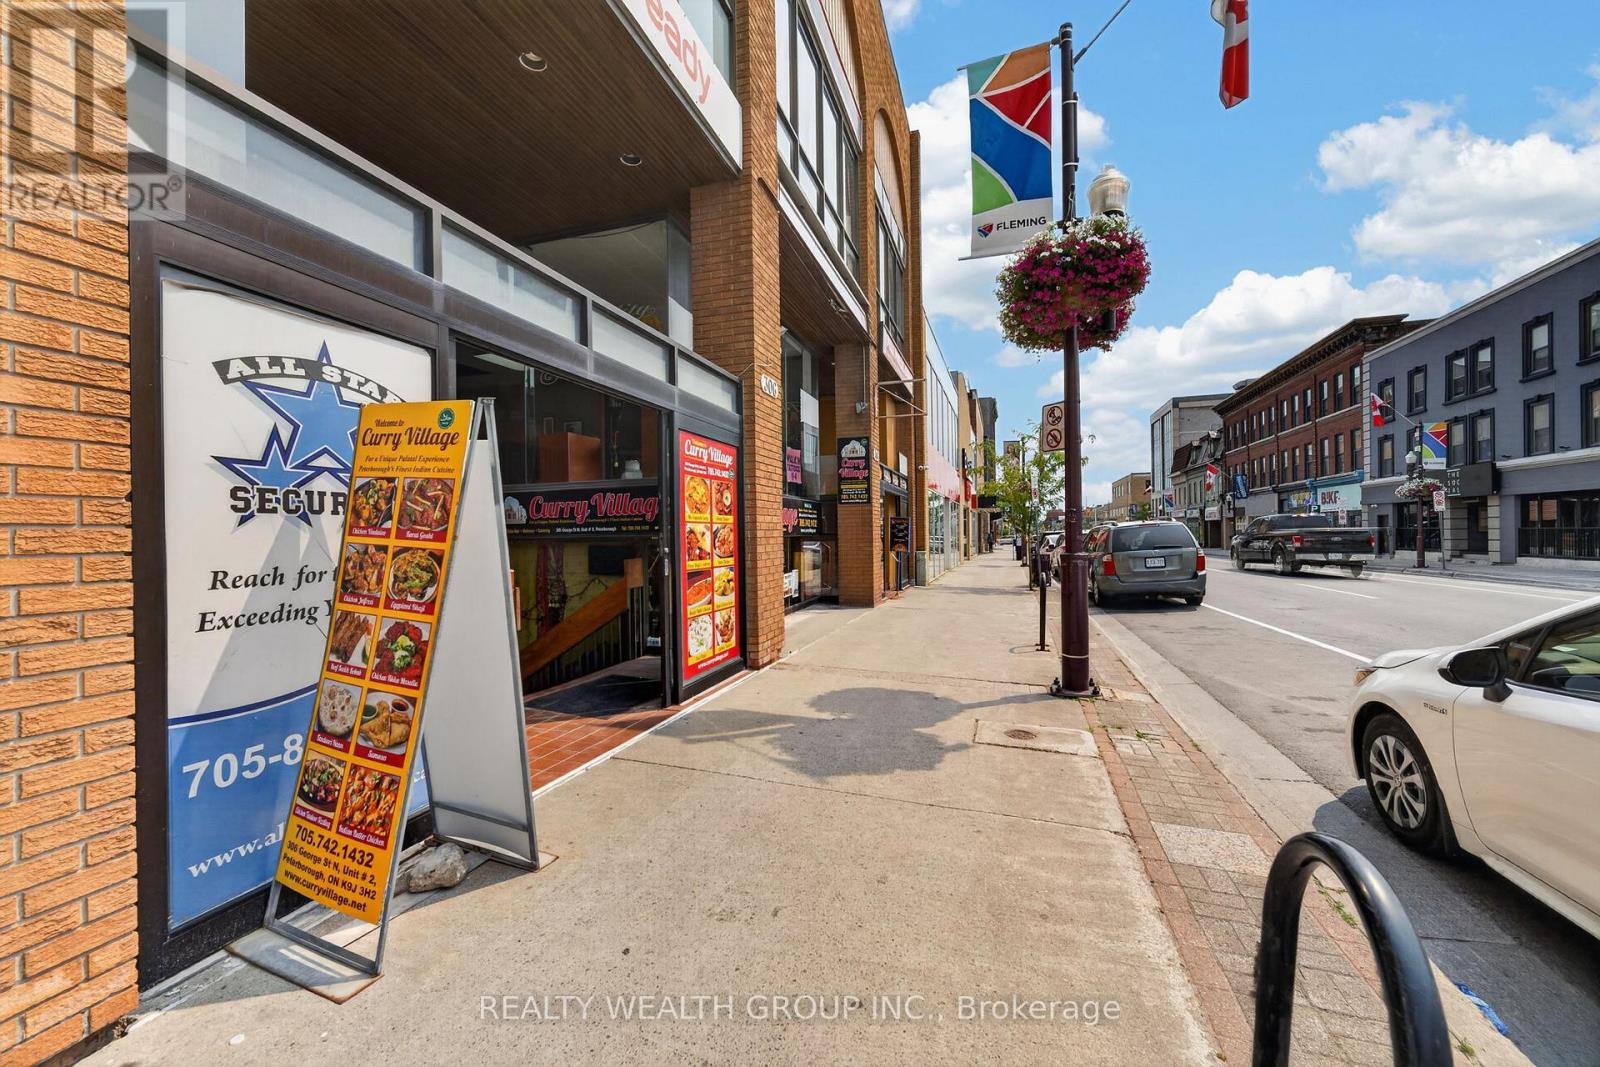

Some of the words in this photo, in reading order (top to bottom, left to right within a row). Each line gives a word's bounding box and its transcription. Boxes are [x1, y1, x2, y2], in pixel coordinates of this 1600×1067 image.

[996, 216, 1047, 231] FLEMING
[226, 356, 306, 379] ALL
[361, 427, 402, 451] Curry
[404, 426, 460, 451] Village
[684, 439, 708, 463] Curry
[709, 446, 733, 468] Village
[841, 458, 865, 469] Curry
[839, 468, 869, 479] Village
[528, 495, 591, 524] Curry
[208, 566, 285, 591] Reach
[292, 564, 328, 591] for
[195, 602, 320, 633] Exceeding
[182, 734, 304, 799] 705-8
[295, 824, 375, 868] 705.742.1432
[366, 833, 385, 846] Chicken
[283, 852, 326, 882] Peterborough,
[328, 874, 340, 886] ON
[340, 880, 358, 894] K9J
[359, 887, 377, 900] 3H2
[287, 840, 298, 852] 306
[298, 846, 322, 864] George
[323, 858, 332, 869] St
[332, 862, 341, 874] N,
[342, 866, 359, 880] Unit
[361, 873, 368, 881] #
[368, 875, 377, 886] 2,
[284, 869, 368, 912] www.curryvillage.net
